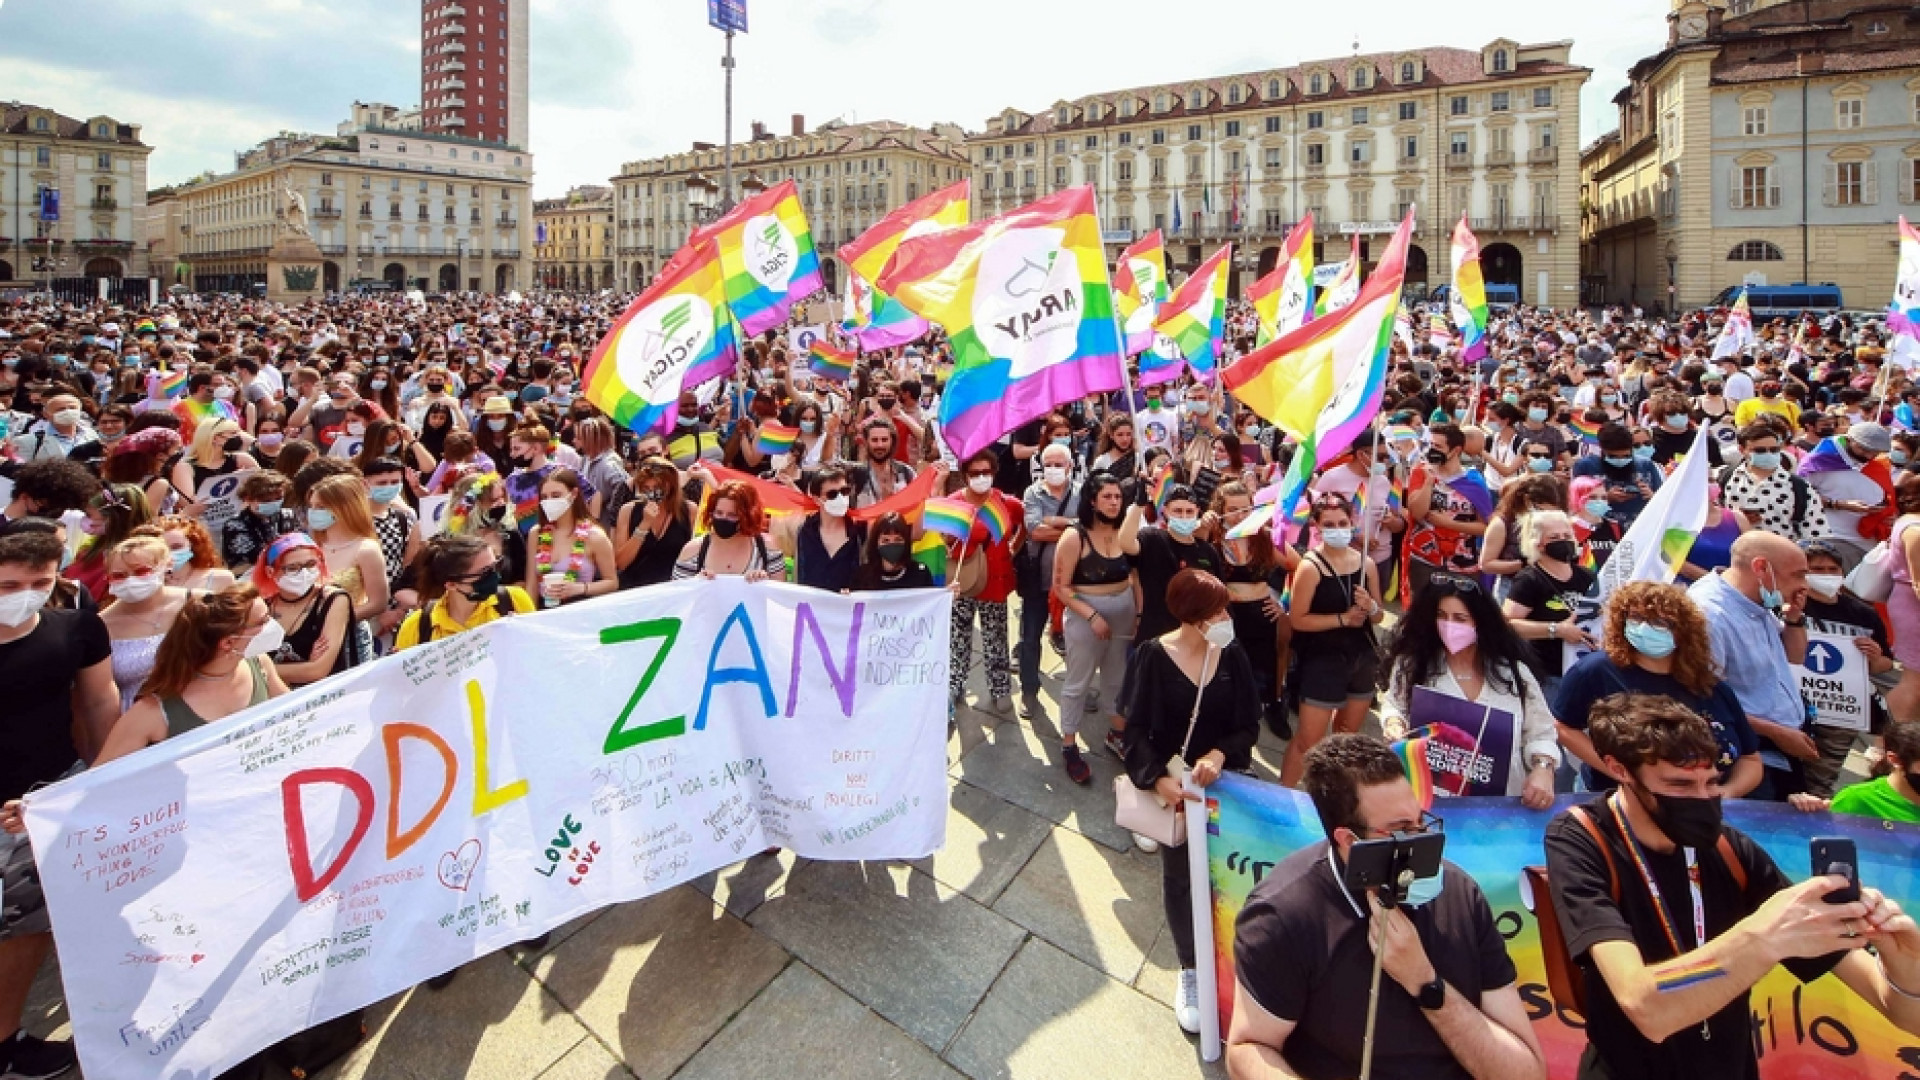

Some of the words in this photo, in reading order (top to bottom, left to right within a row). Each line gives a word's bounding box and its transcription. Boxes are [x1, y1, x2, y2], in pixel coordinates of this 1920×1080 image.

[873, 612, 905, 633] NON
[911, 615, 934, 640] UN
[867, 634, 928, 659] PASSO
[1801, 676, 1843, 692] NON
[1813, 690, 1857, 704] PASSO
[281, 679, 529, 902] DDL
[600, 602, 865, 754] ZAN
[655, 786, 673, 809] LA
[129, 802, 181, 833] SUCH
[535, 813, 583, 877] LOVE
[72, 853, 85, 870] A
[82, 857, 132, 882] THING
[568, 840, 602, 886] LOVE
[105, 860, 159, 892] LOVE
